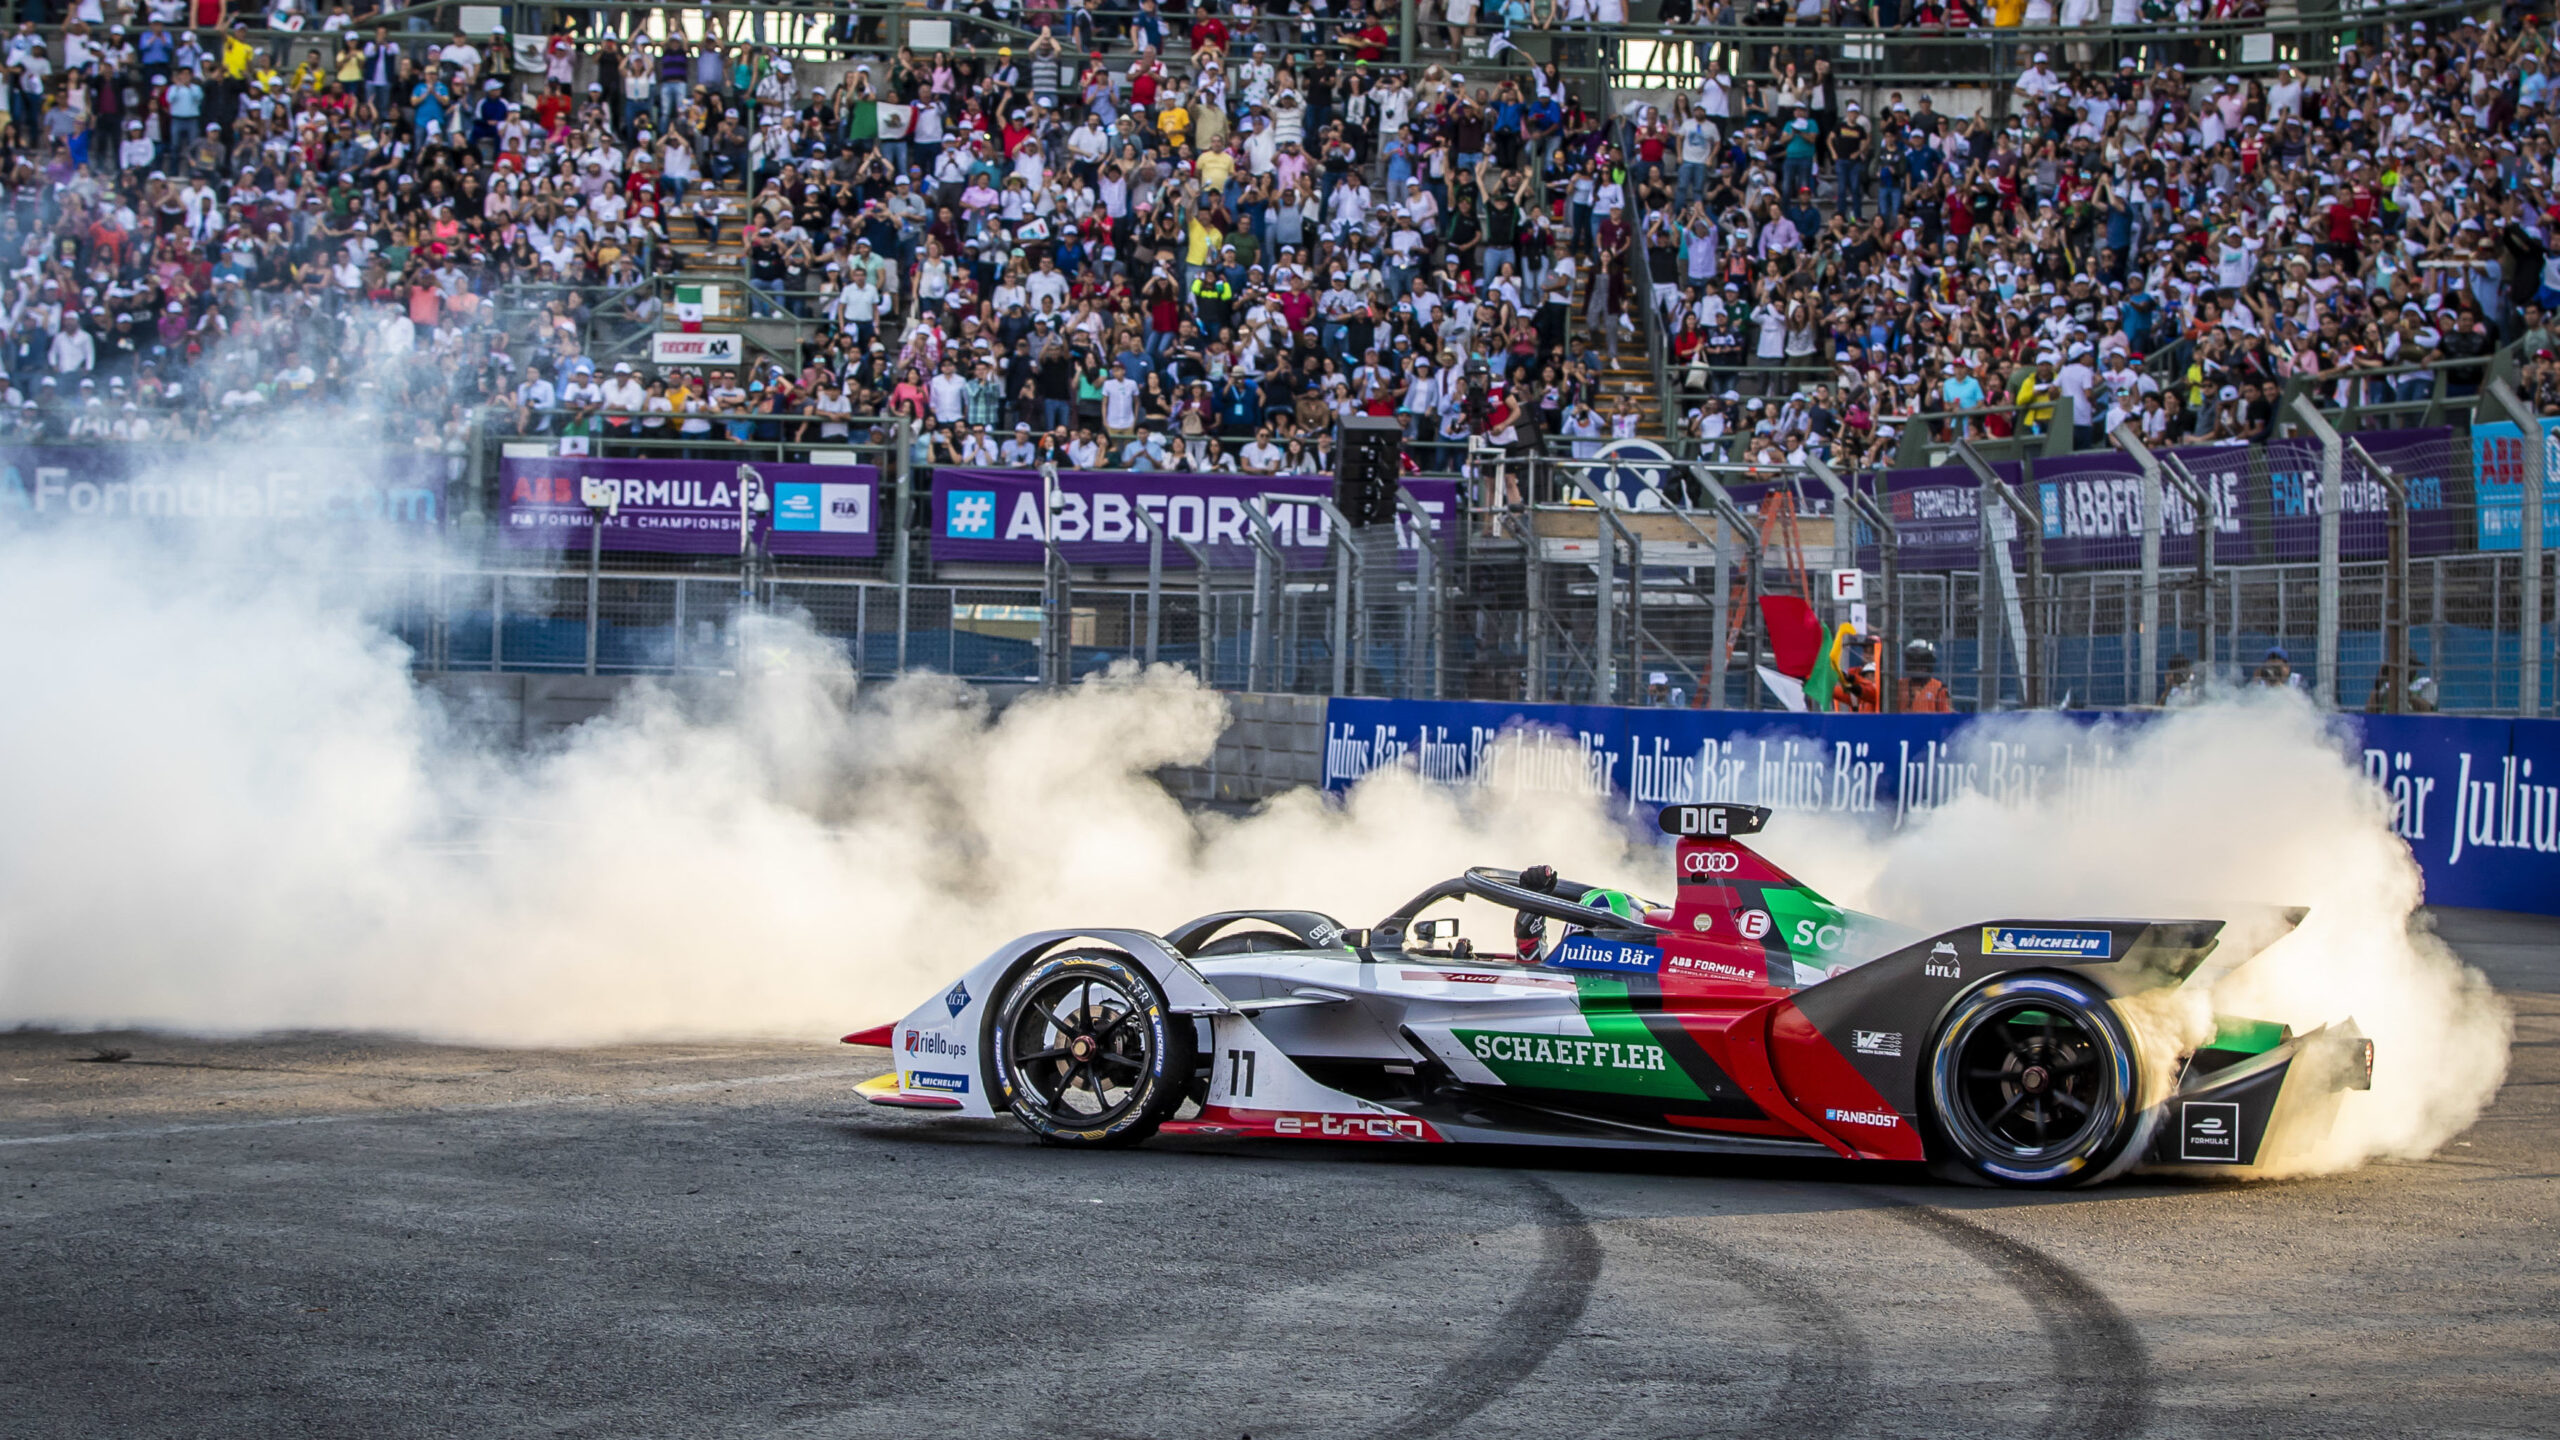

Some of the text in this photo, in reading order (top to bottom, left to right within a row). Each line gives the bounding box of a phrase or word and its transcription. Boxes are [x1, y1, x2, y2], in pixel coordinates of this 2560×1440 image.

[512, 477, 572, 503] ABB
[833, 502, 857, 514] FIA
[540, 515, 629, 528] FORMUA-E
[638, 518, 756, 531] CHAMPIONSHP
[1838, 573, 1856, 596] F
[1324, 722, 1369, 790] Julius
[1577, 731, 1618, 797] Bär
[1628, 735, 1746, 815] Julius Bär
[1756, 740, 1885, 813] Julius Bär
[1680, 807, 1727, 834] DIG
[2448, 752, 2560, 865] Juliu
[1559, 943, 1655, 966] Julius Bär
[2018, 937, 2100, 950] MICHELIN
[1669, 956, 1692, 968] ABB
[1925, 964, 1961, 979] HYLA
[1452, 974, 1498, 983] Audi
[920, 1031, 967, 1060] riello ups
[1155, 1023, 1165, 1074] MICHELIN
[1474, 1034, 1666, 1071] SCHAEFFLER
[921, 1077, 963, 1089] MICHELIN
[1228, 1048, 1256, 1098] 11
[1274, 1113, 1423, 1137] e-tron
